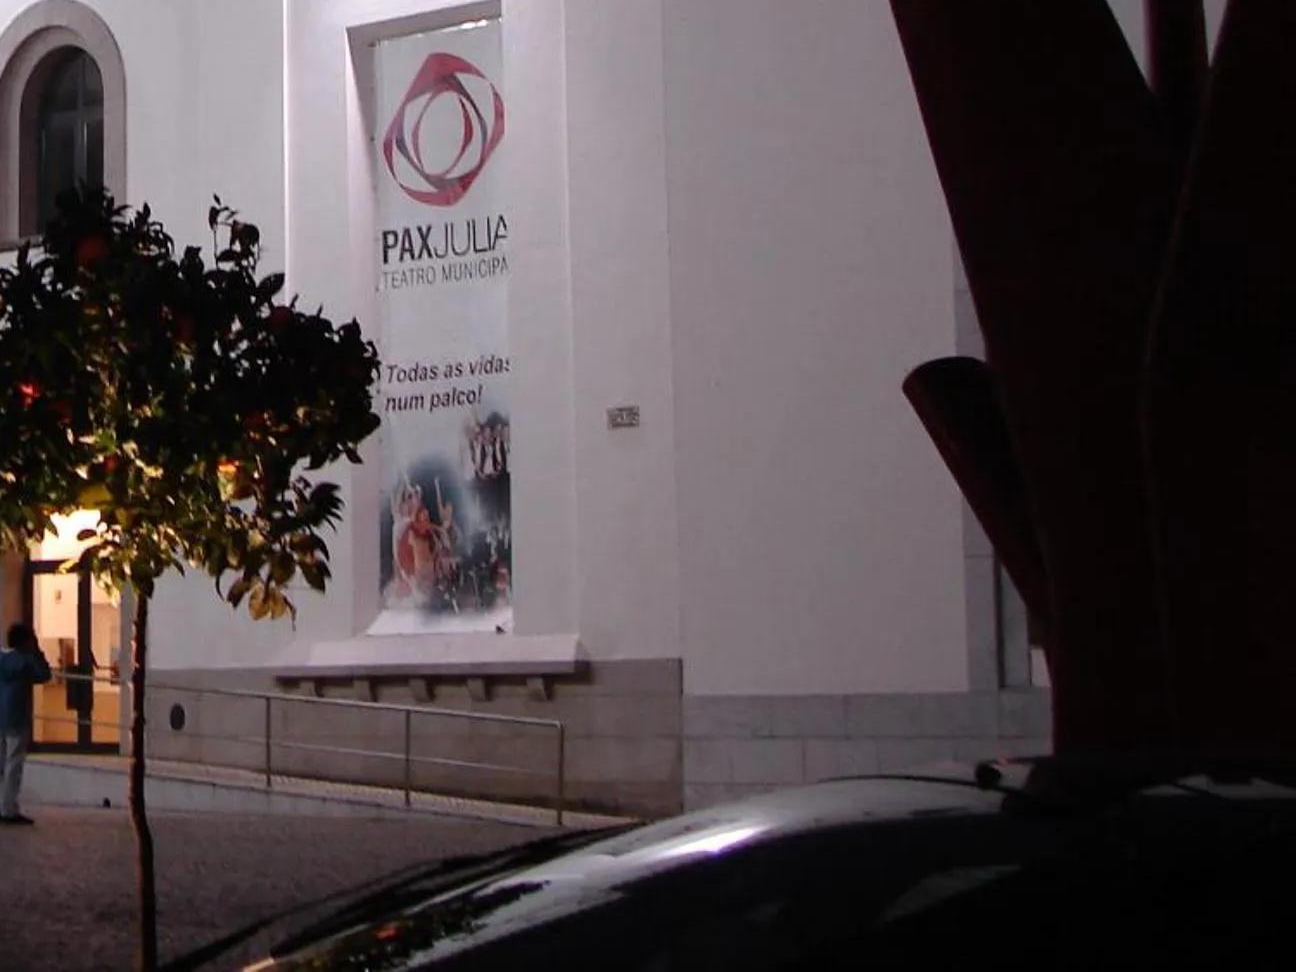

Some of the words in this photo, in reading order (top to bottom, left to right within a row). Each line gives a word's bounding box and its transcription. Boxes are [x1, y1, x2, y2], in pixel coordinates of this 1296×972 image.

[383, 265, 436, 290] TEATRO
[441, 253, 508, 282] MUNICIPA
[386, 361, 438, 384] Todas
[443, 363, 463, 377] as
[385, 394, 424, 412] num
[429, 384, 483, 413] palco!
